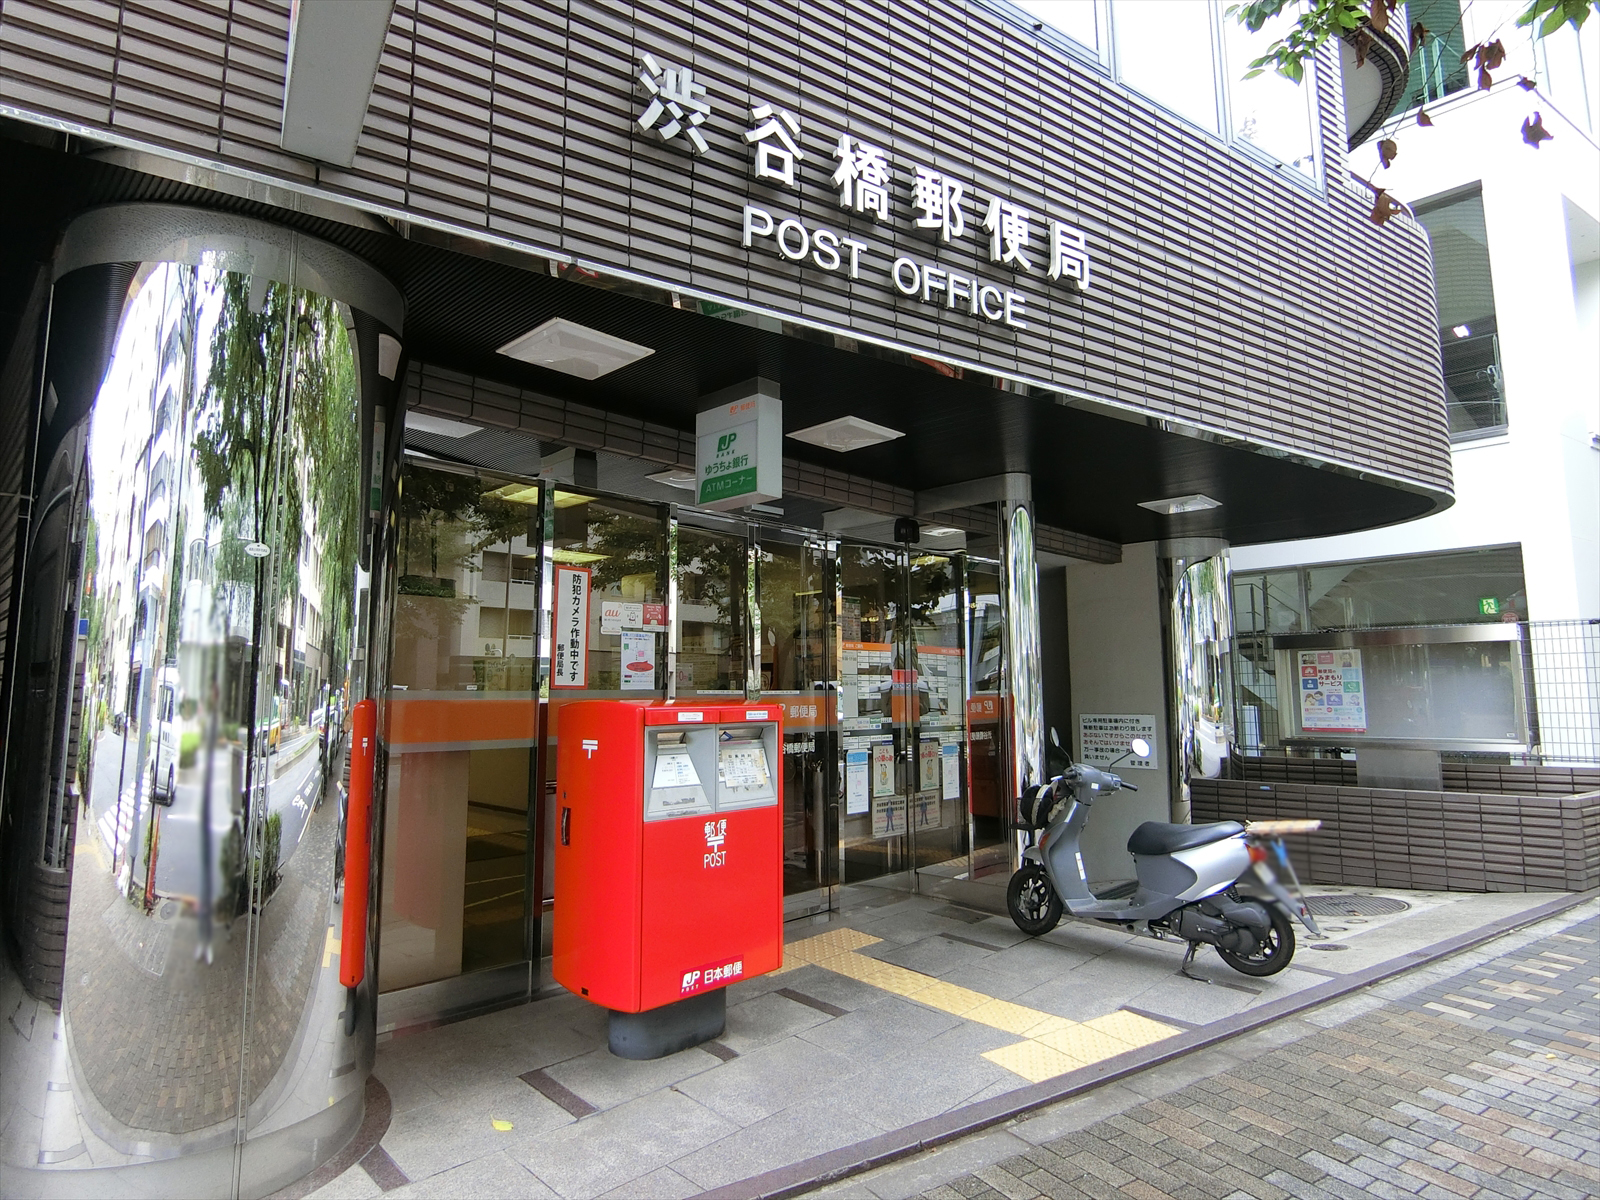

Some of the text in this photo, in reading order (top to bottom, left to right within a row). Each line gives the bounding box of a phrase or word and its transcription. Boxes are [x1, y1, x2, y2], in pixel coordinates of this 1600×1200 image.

[634, 52, 1091, 291] 渋谷橋郵便局
[742, 204, 1028, 330] POST OFFICE
[717, 433, 737, 452] JP
[705, 454, 748, 475] ゆうちょ銀行
[705, 475, 753, 493] ATMコーナー
[604, 609, 620, 617] au
[569, 574, 582, 682] 防犯カメラ作動中です
[556, 644, 565, 676] 郵便局長
[789, 704, 818, 718] 郵便局
[704, 819, 727, 838] 郵便
[703, 851, 727, 869] POST
[682, 960, 743, 988] JP 日本郵便
[681, 984, 699, 993] POST
